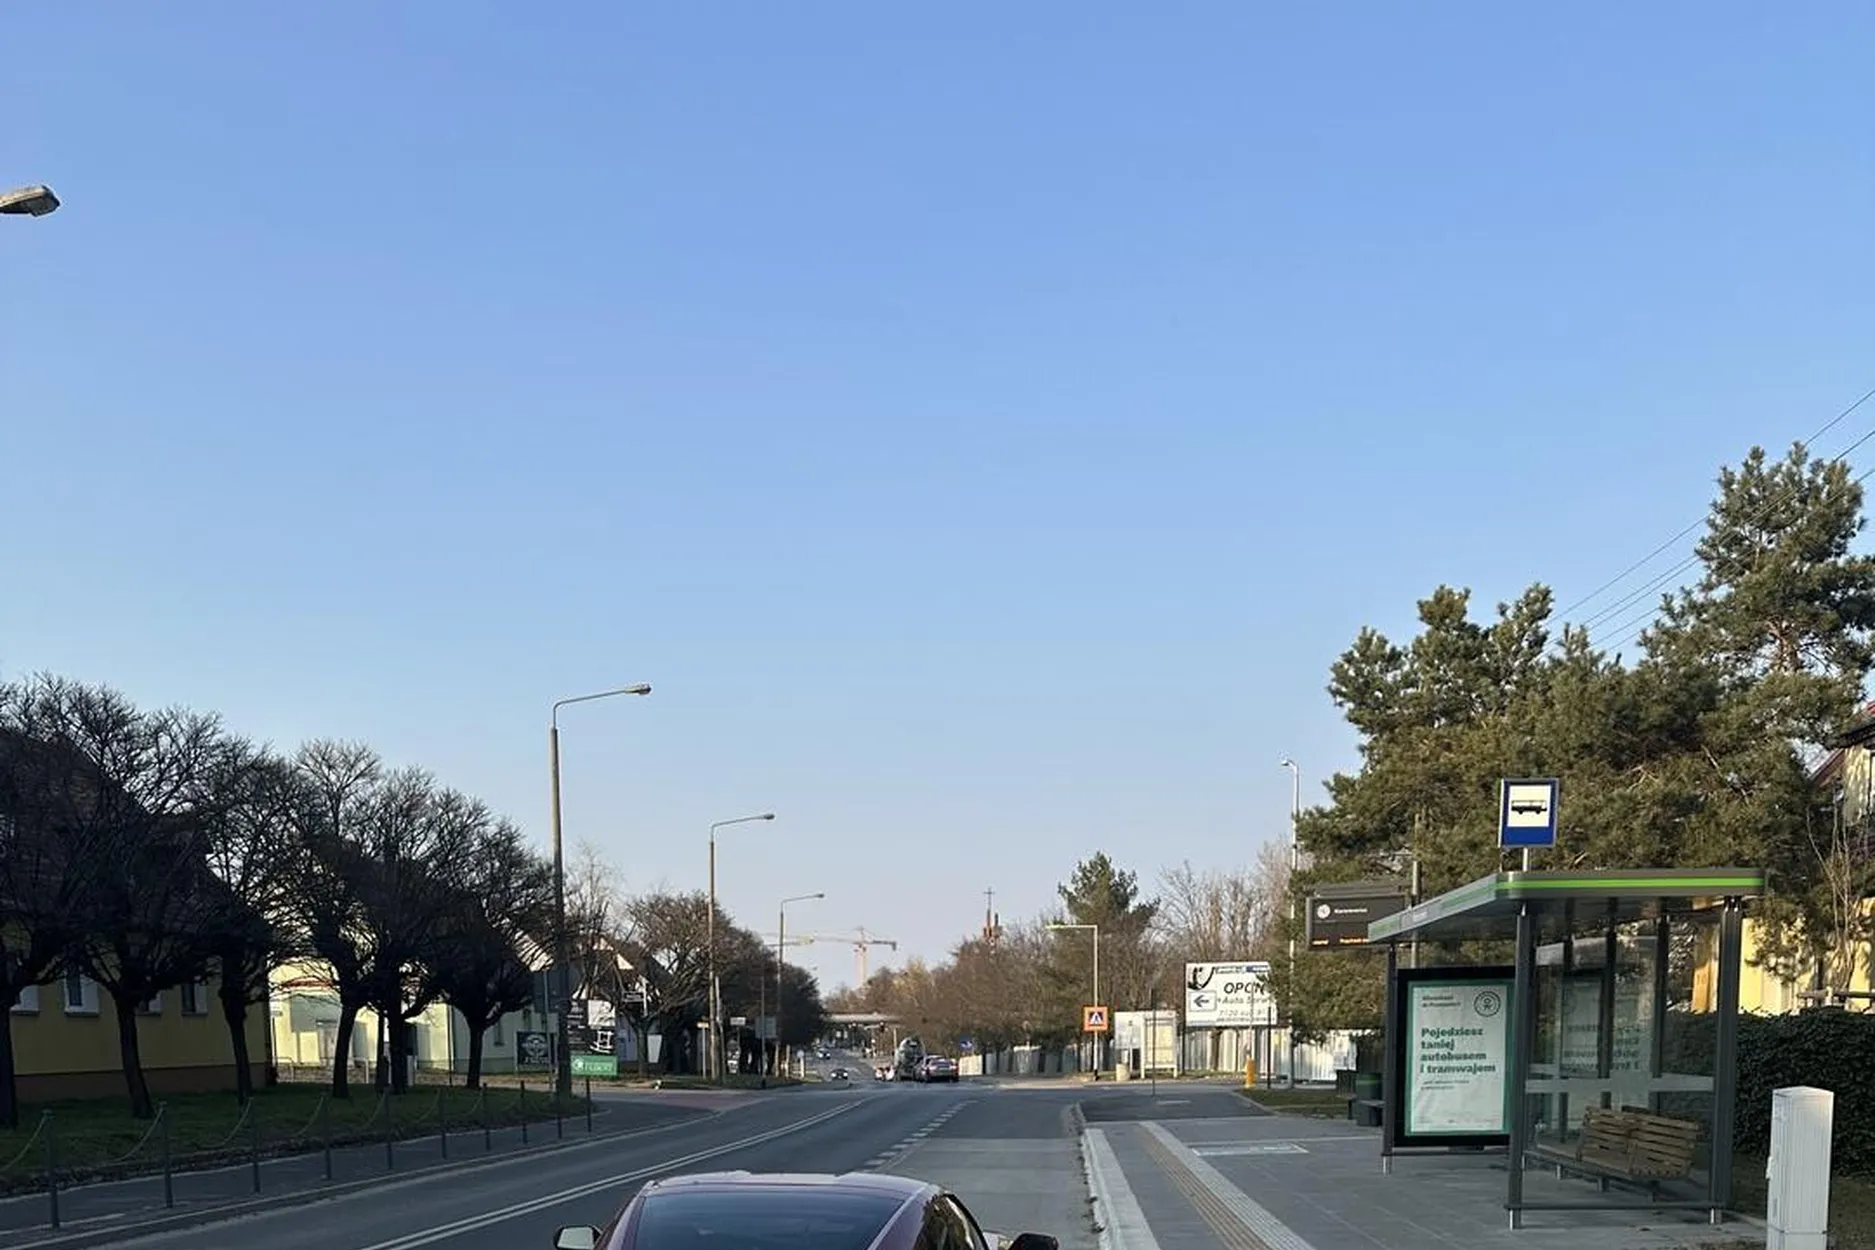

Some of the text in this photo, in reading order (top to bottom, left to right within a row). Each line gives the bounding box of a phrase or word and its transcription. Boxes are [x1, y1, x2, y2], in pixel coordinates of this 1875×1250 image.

[1421, 1027, 1484, 1038] Pojedziesz
[1421, 1039, 1455, 1051] taniej
[1421, 1052, 1487, 1061] autobusem
[1427, 1063, 1496, 1075] tramwajem
